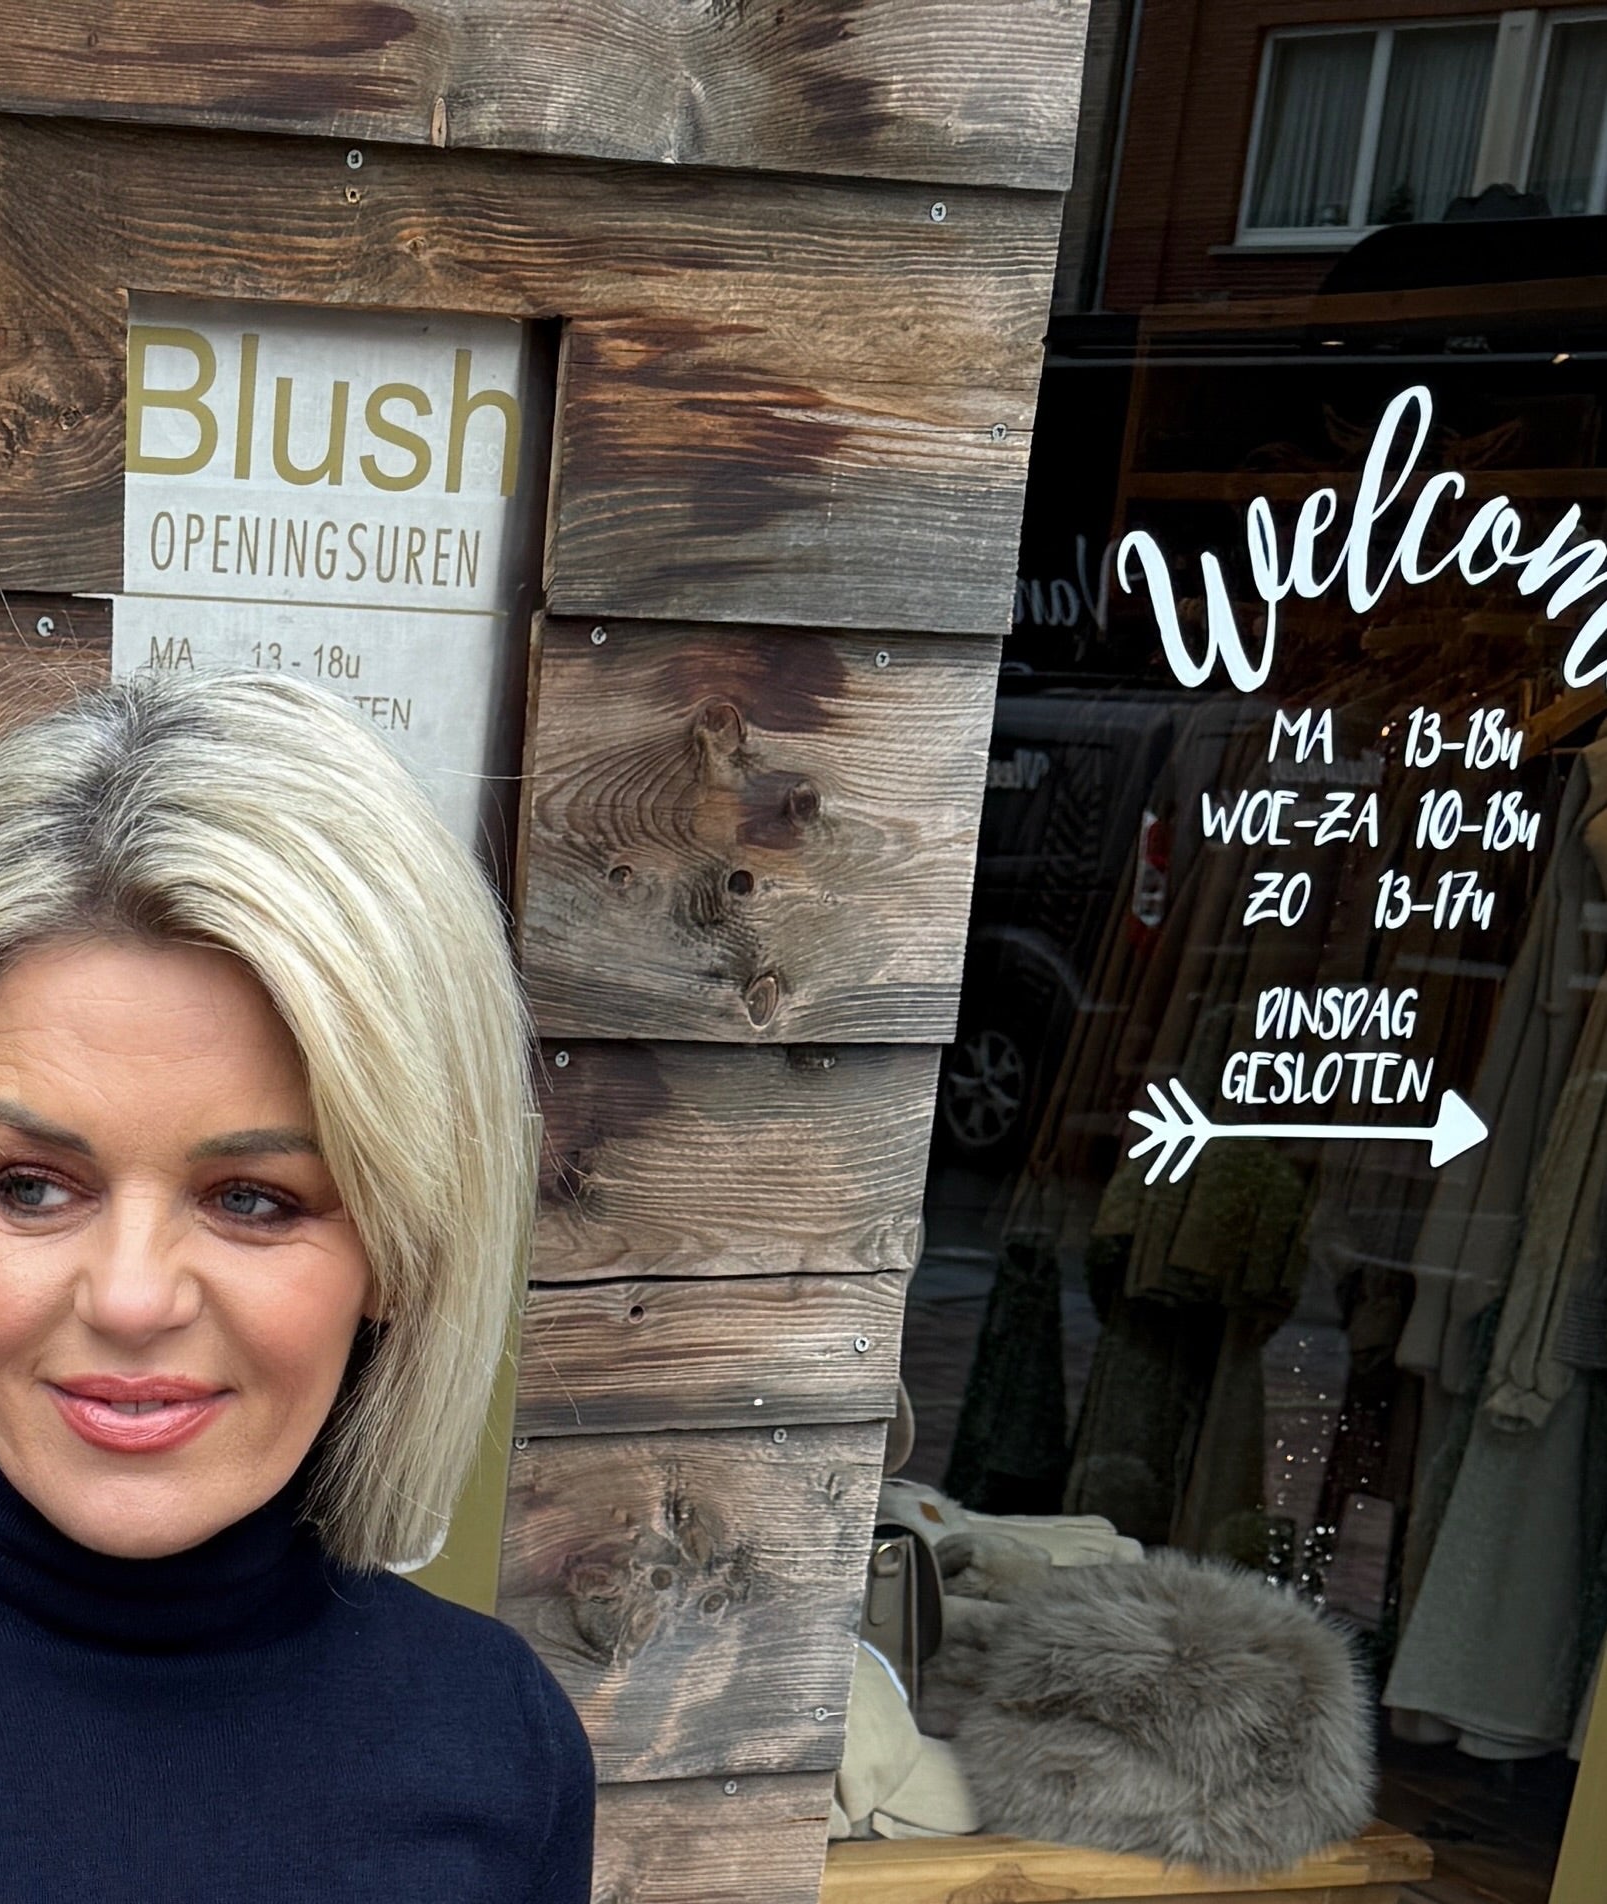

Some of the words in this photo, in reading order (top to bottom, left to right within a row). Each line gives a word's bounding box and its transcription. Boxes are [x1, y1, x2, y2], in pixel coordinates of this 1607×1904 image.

[125, 325, 523, 497] Blush
[150, 511, 481, 588] OPENINGSUREN
[1117, 385, 1607, 692] Welcom
[148, 636, 194, 671] MA
[313, 643, 361, 679] 18u
[1268, 708, 1333, 765] MA
[1404, 706, 1524, 770] 13-18u
[1202, 789, 1378, 848] WOE-ZA
[1416, 789, 1541, 852] 10-18u
[1243, 872, 1311, 927] ZO
[1374, 869, 1495, 931] 13-17u
[1255, 986, 1418, 1040] DINSDAG
[1221, 1051, 1434, 1105] GESLOTEN
